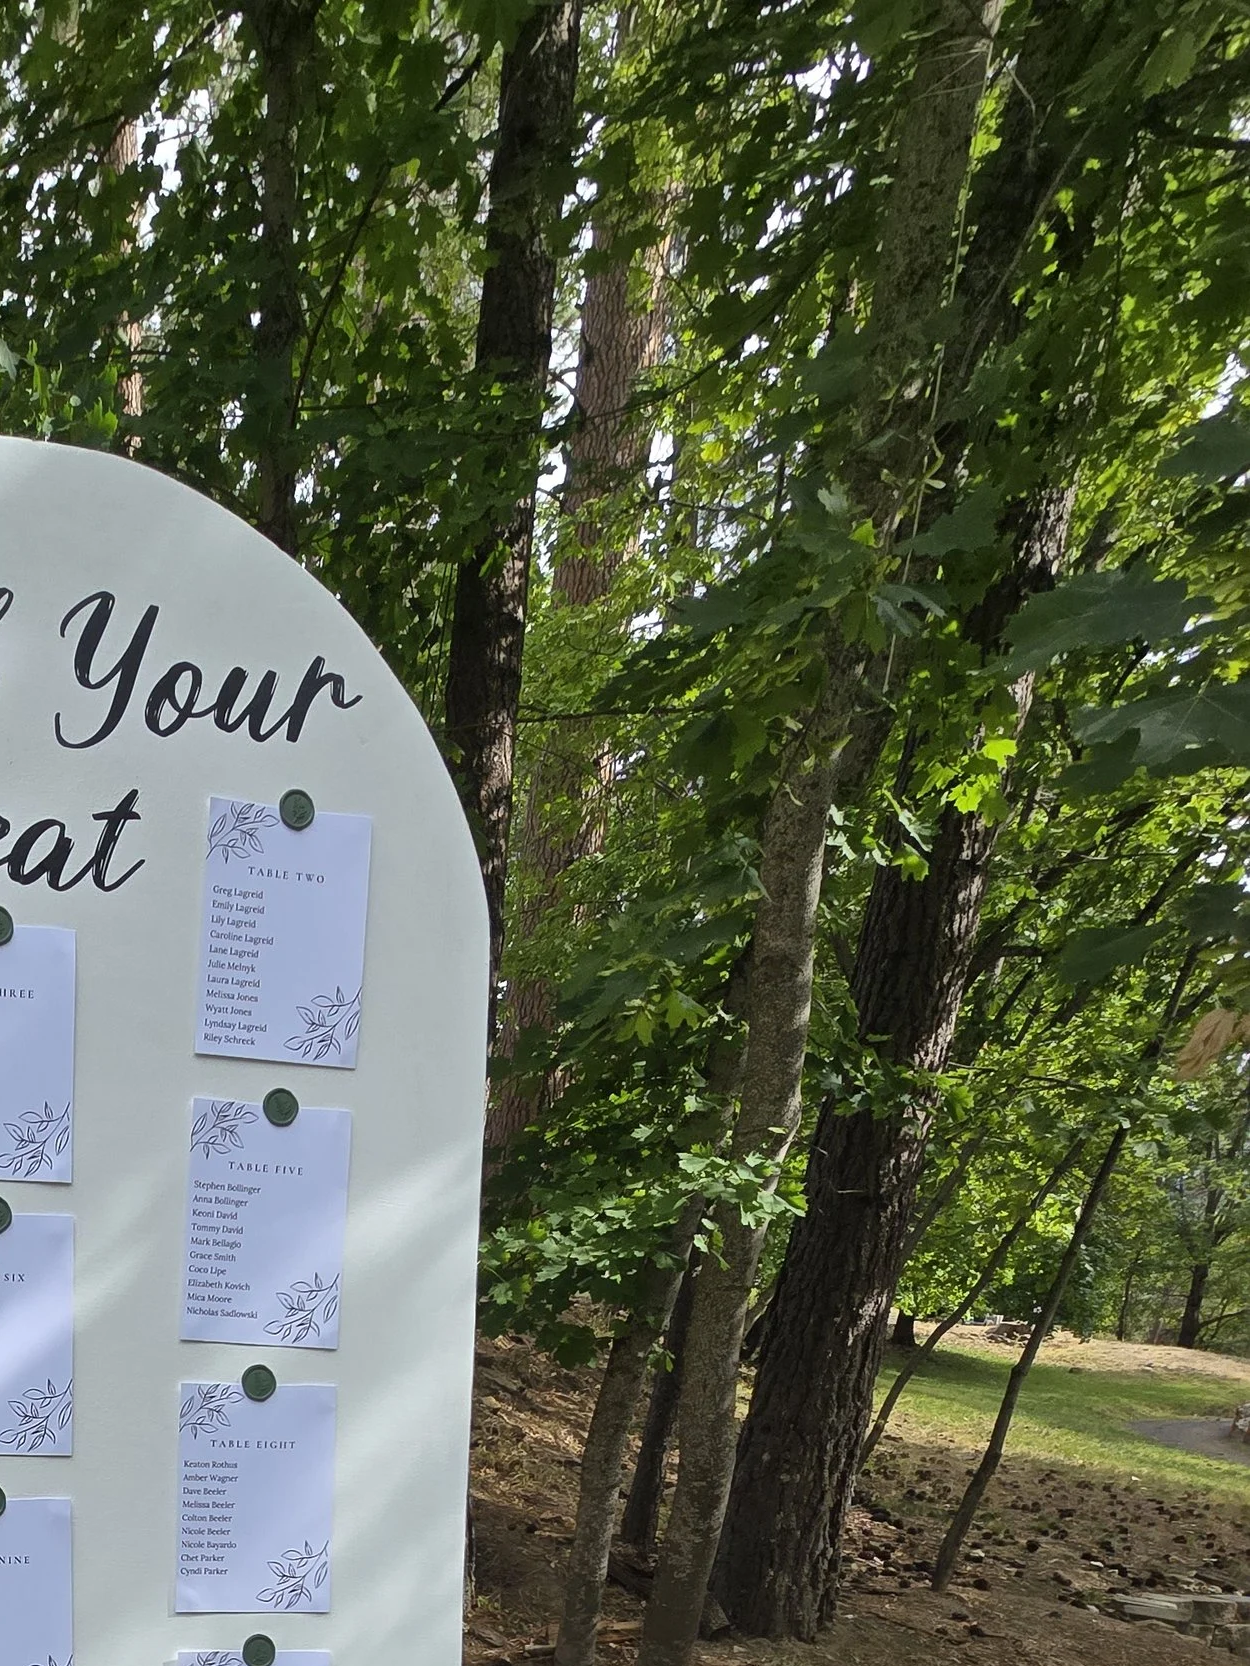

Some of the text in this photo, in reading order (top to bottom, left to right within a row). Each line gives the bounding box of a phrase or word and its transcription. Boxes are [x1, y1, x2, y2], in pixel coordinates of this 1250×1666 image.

[55, 591, 362, 748] Your
[248, 866, 325, 884] TABLE TWO
[212, 899, 265, 915] Emily Lagreid
[205, 1003, 252, 1017] Wyatt Jones
[203, 1032, 256, 1046] Riley Schreck
[228, 1161, 303, 1176] TABLE FIVE
[193, 1180, 261, 1196] Stephen Bollinger
[190, 1222, 244, 1236] Tommy David
[189, 1250, 236, 1262] Grace Smith
[4, 1273, 25, 1282] SIX
[209, 1439, 296, 1449] TABLE EIGHT
[182, 1486, 227, 1496] Dave Beeler
[180, 1553, 225, 1562] Chet Parker
